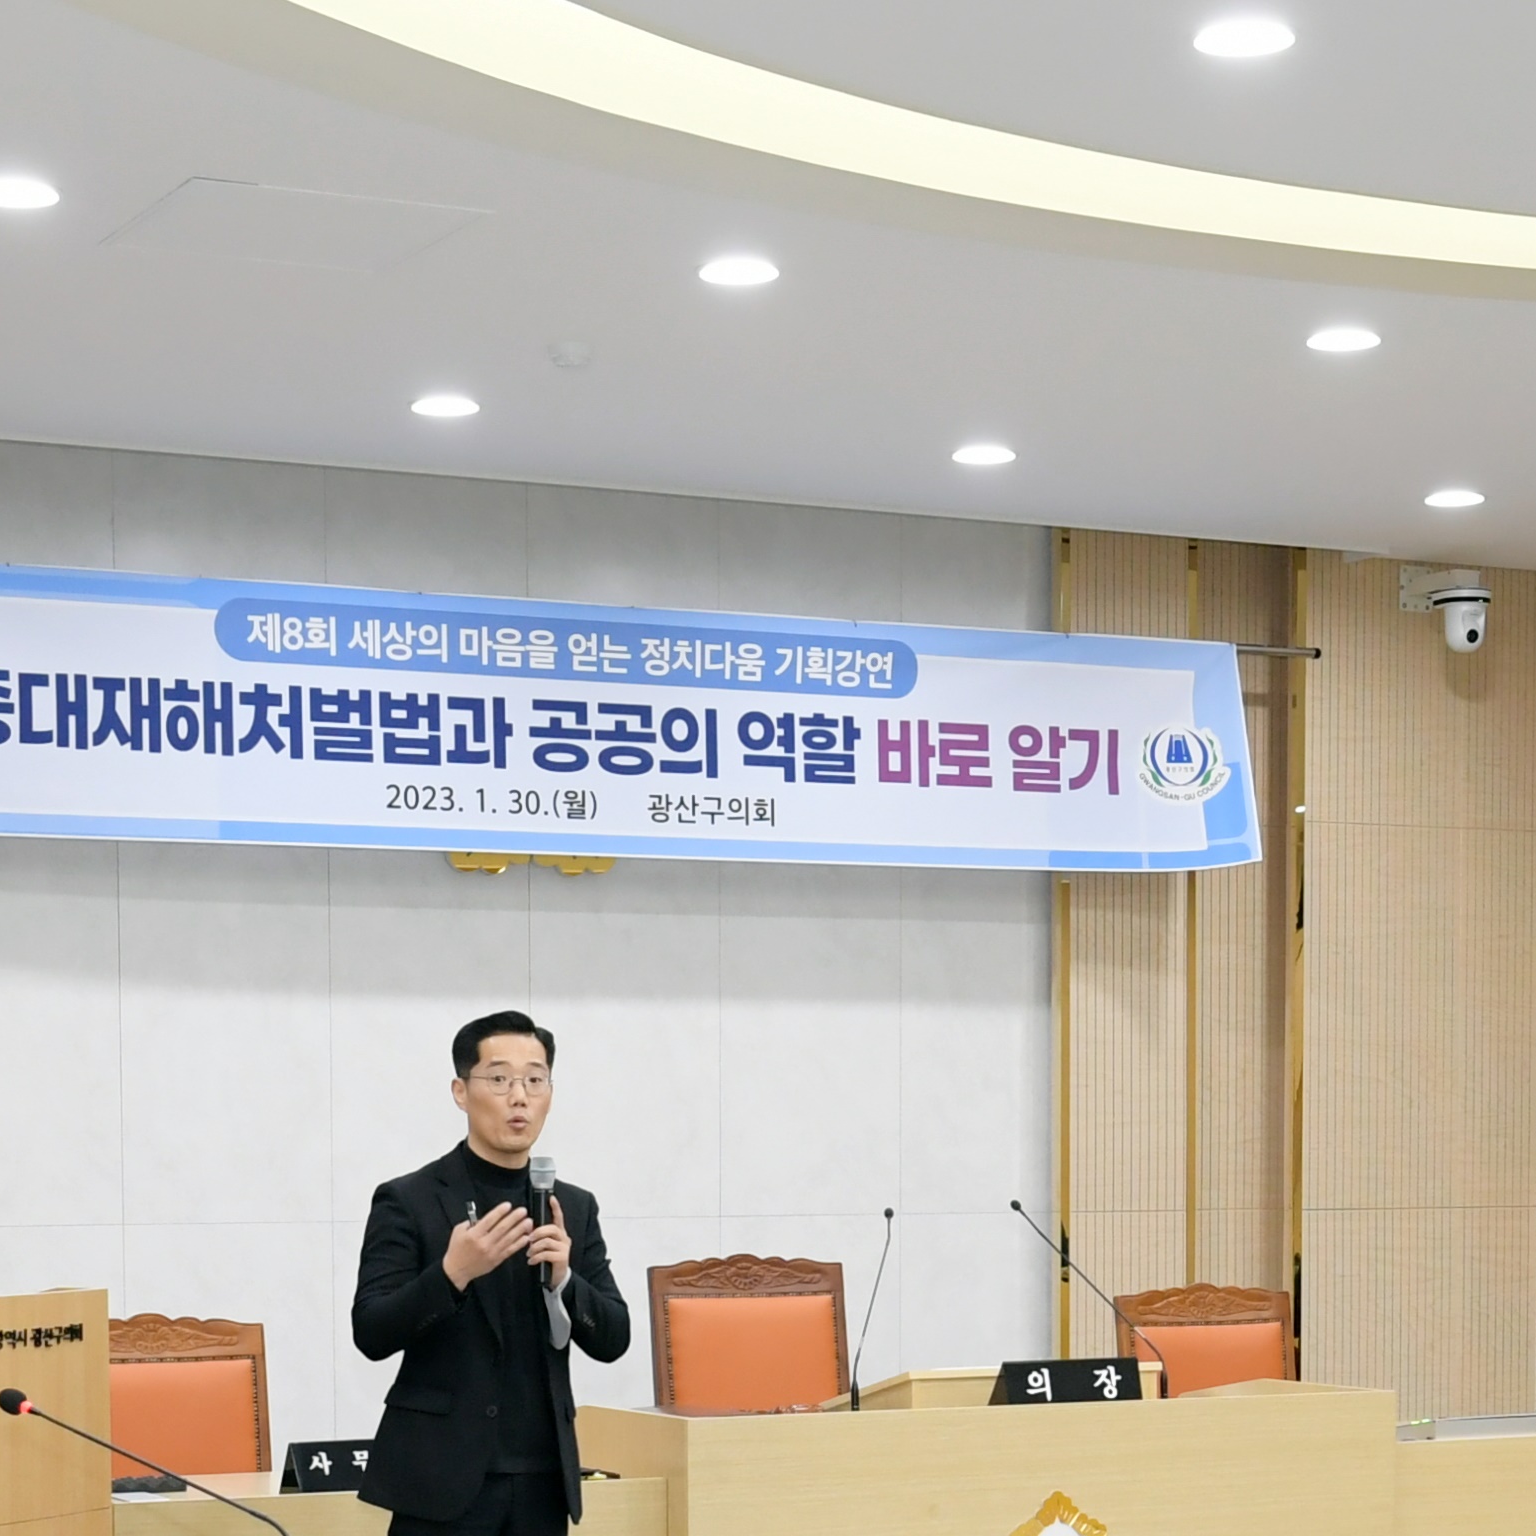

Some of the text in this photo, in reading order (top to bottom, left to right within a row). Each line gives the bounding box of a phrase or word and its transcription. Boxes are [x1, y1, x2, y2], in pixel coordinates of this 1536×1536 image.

[246, 613, 894, 689] 제8회 세상의 마음을 얻는 정치다움 기획강연
[528, 697, 720, 780] 공공의
[737, 710, 861, 785] 역할
[877, 717, 994, 789] 바로
[1008, 723, 1121, 796] 알기
[385, 784, 776, 827] 2023. 1. 30.(월) 광산구의회
